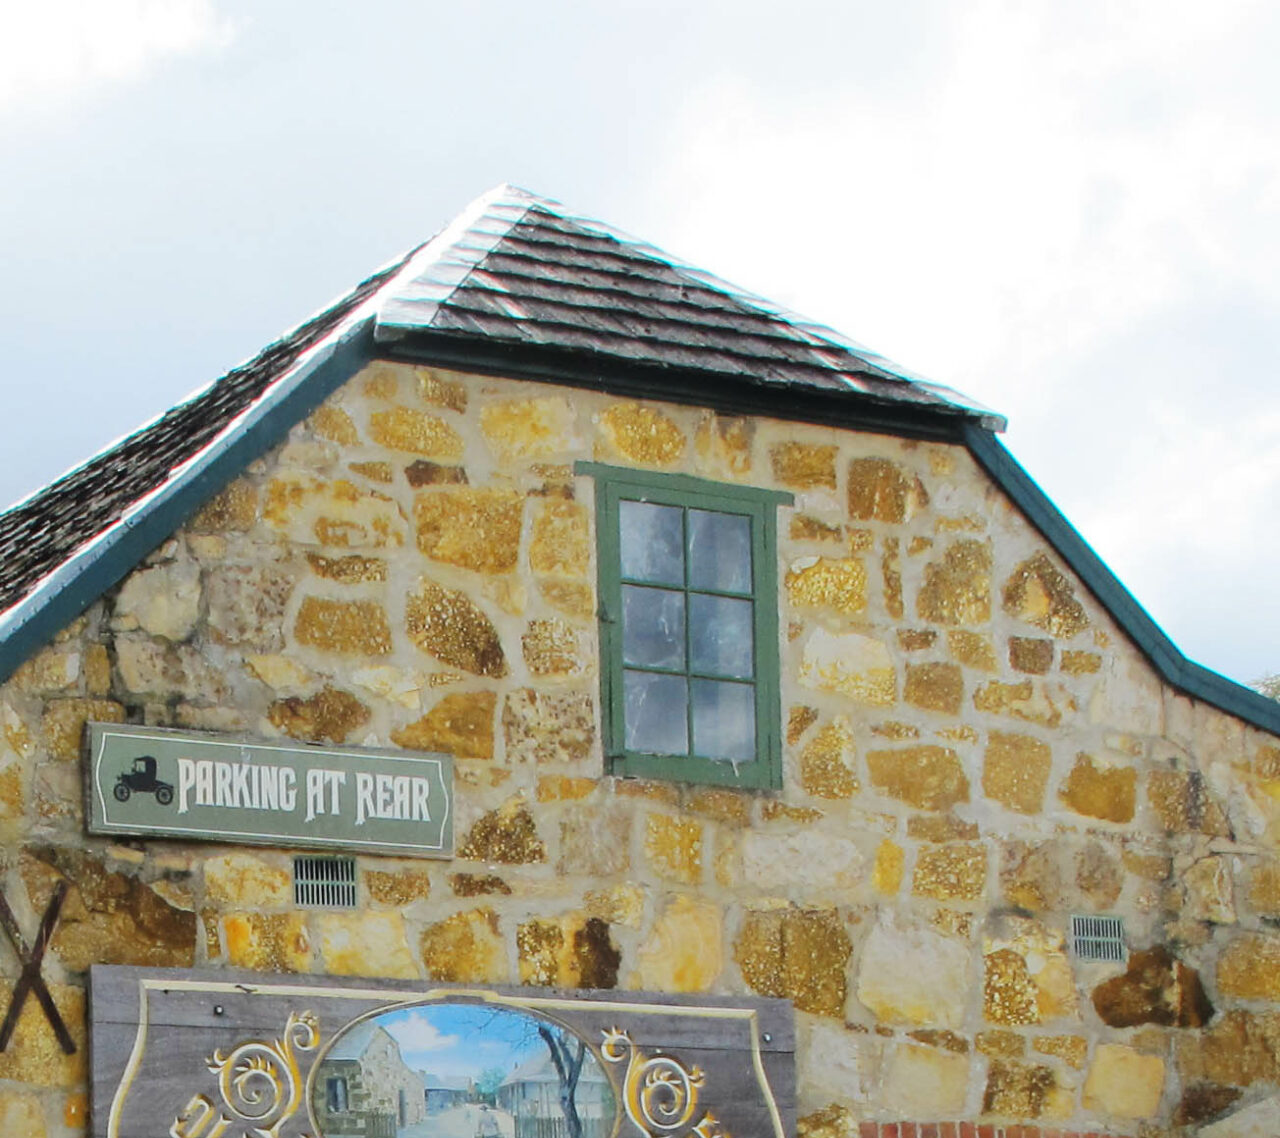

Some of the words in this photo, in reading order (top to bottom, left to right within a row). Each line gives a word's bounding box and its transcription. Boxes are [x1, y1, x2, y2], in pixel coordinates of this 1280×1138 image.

[177, 758, 298, 814] PARKING
[304, 768, 346, 823] AT
[355, 772, 431, 826] REAR
